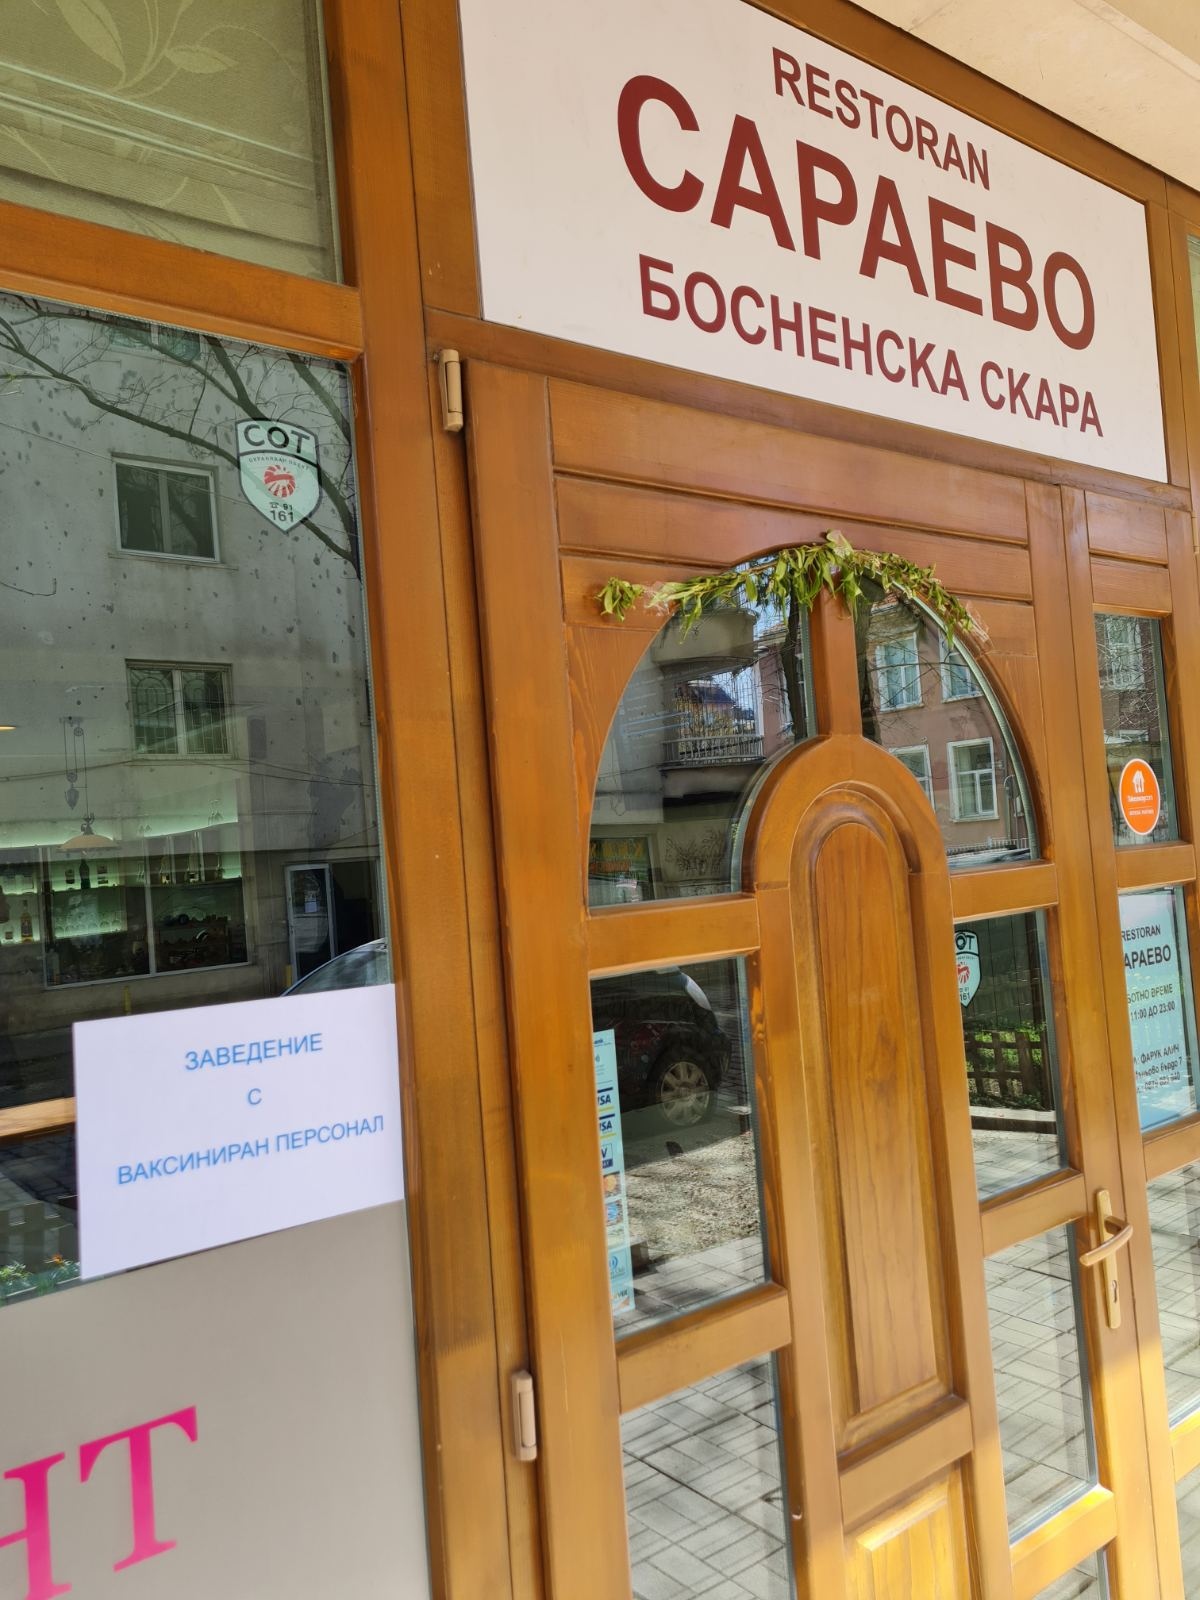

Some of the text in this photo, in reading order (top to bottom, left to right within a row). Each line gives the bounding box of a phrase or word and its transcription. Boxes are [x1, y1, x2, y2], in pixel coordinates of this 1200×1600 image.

[772, 46, 990, 191] RESTORAN
[617, 74, 1095, 350] САРАЕВО
[639, 253, 1104, 438] БОСНЕНСКА СКАРА
[243, 424, 310, 453] СОТ
[270, 509, 294, 523] 161
[1121, 924, 1161, 941] RESTORAN
[1151, 983, 1173, 998] ВРЕМЕ
[1148, 1004, 1158, 1017] ДО
[1159, 1000, 1176, 1013] 23:00
[184, 1032, 323, 1071] ЗАВЕДЕНИЕ
[1140, 1049, 1162, 1064] ФАРУК
[247, 1087, 262, 1106] С
[117, 1115, 384, 1185] ВАКСИНИРАН ПЕРСОНАЛ
